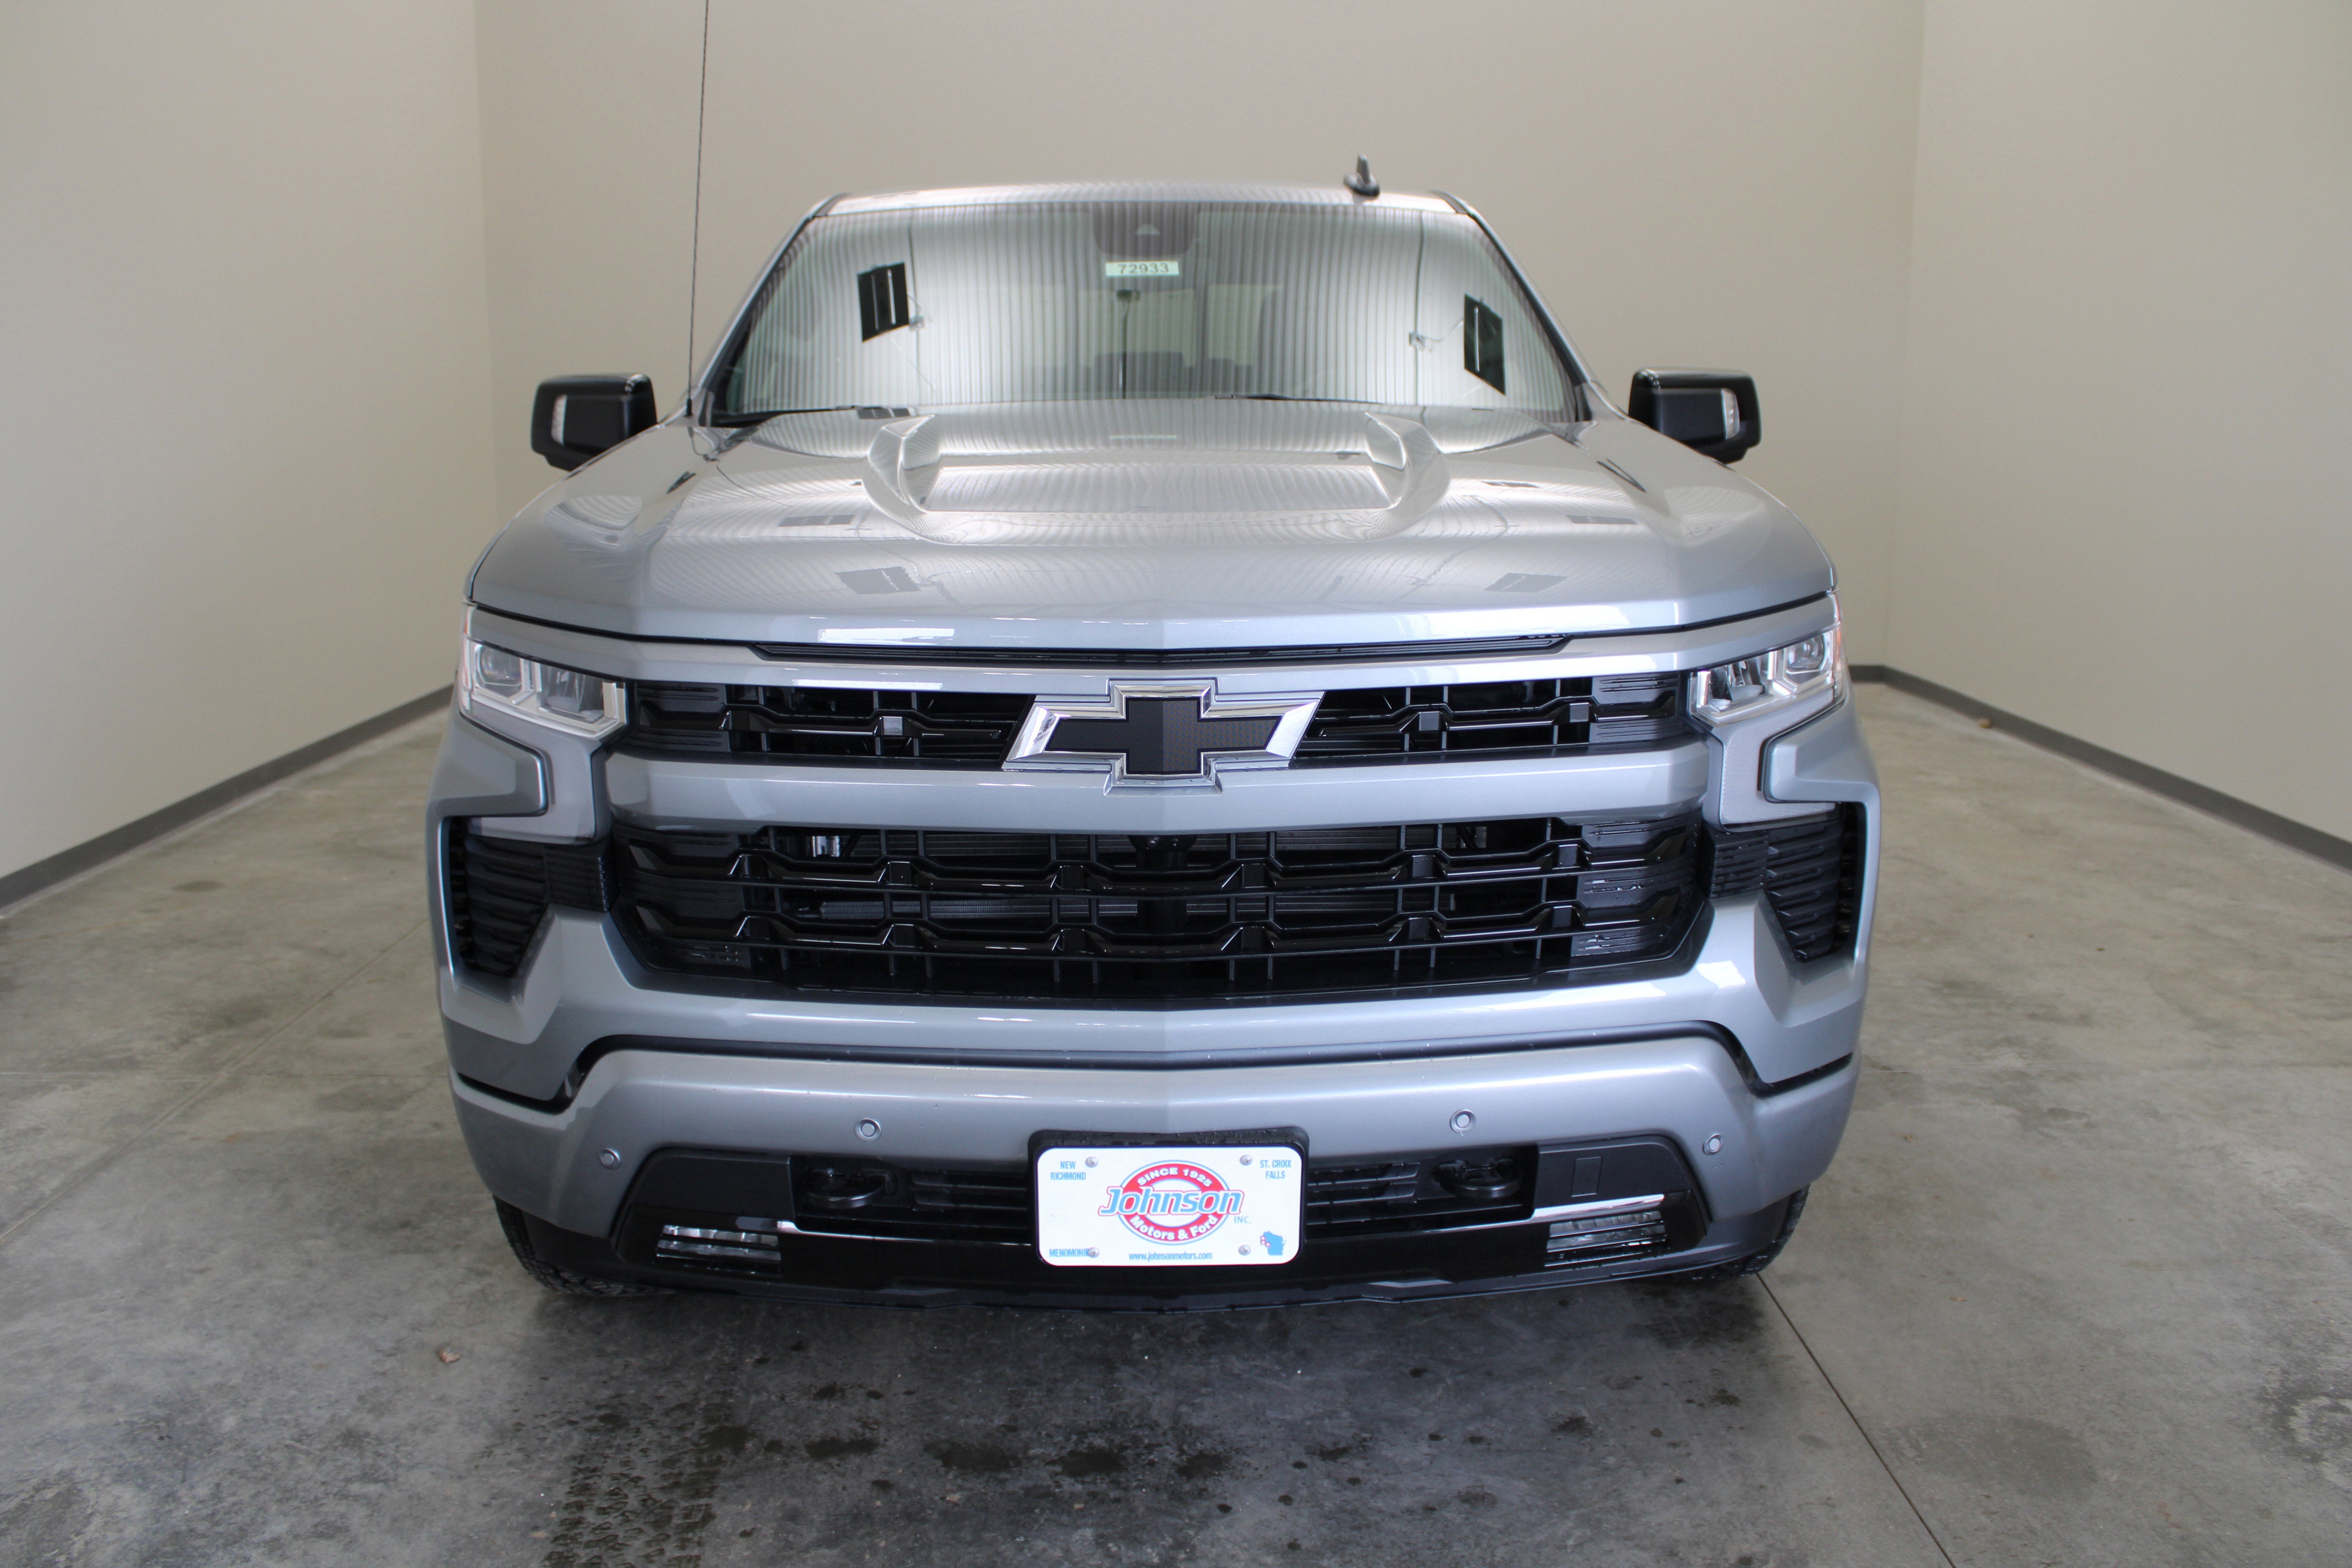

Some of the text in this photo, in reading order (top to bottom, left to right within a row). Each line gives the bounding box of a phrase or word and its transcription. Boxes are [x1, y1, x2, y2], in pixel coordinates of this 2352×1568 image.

[1118, 262, 1169, 274] 72933
[1060, 1160, 1076, 1169] NEW
[1260, 1159, 1292, 1168] ST. CROIX
[1050, 1172, 1086, 1180] RICHMOND
[1137, 1167, 1212, 1187] SINCE 1925
[1265, 1170, 1285, 1179] FALLS
[1099, 1187, 1243, 1214] Johnson
[1234, 1216, 1252, 1224] INC.
[1129, 1214, 1218, 1241] Motors & Ford
[1129, 1252, 1212, 1262] www.johnsonmotors.com
